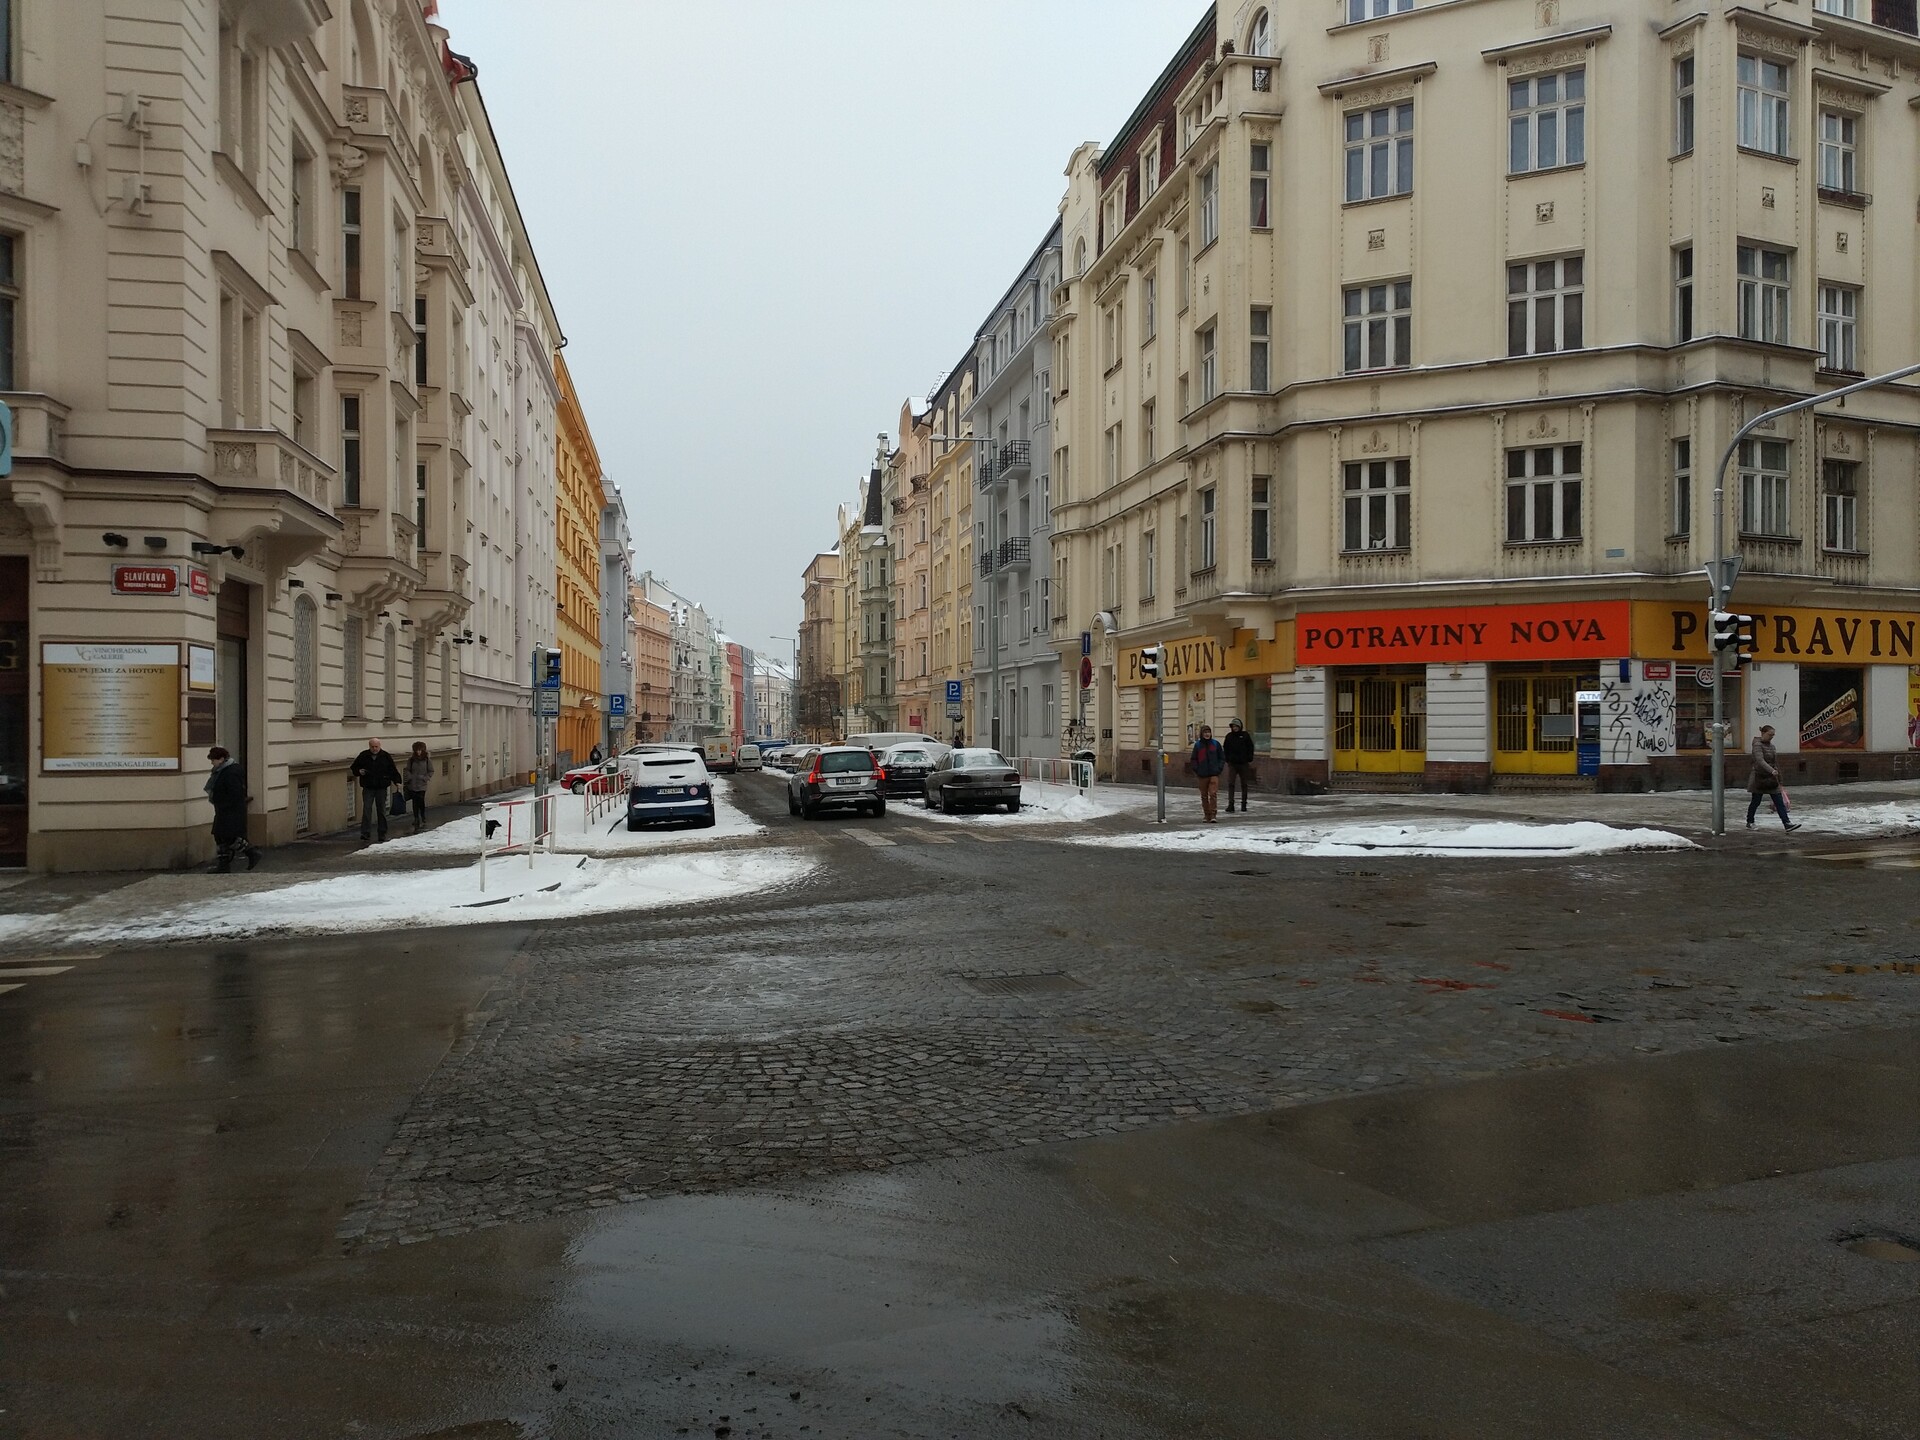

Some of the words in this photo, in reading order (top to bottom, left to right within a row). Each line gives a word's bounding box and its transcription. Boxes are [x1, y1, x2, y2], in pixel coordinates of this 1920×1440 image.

[124, 571, 166, 581] SLAVÍKOVA
[1305, 622, 1488, 649] POTRAVINY
[1510, 618, 1607, 644] NOVA
[1671, 610, 1916, 658] PTRAVIN
[1129, 641, 1226, 680] PORAVINY
[1801, 721, 1833, 742] mentos
